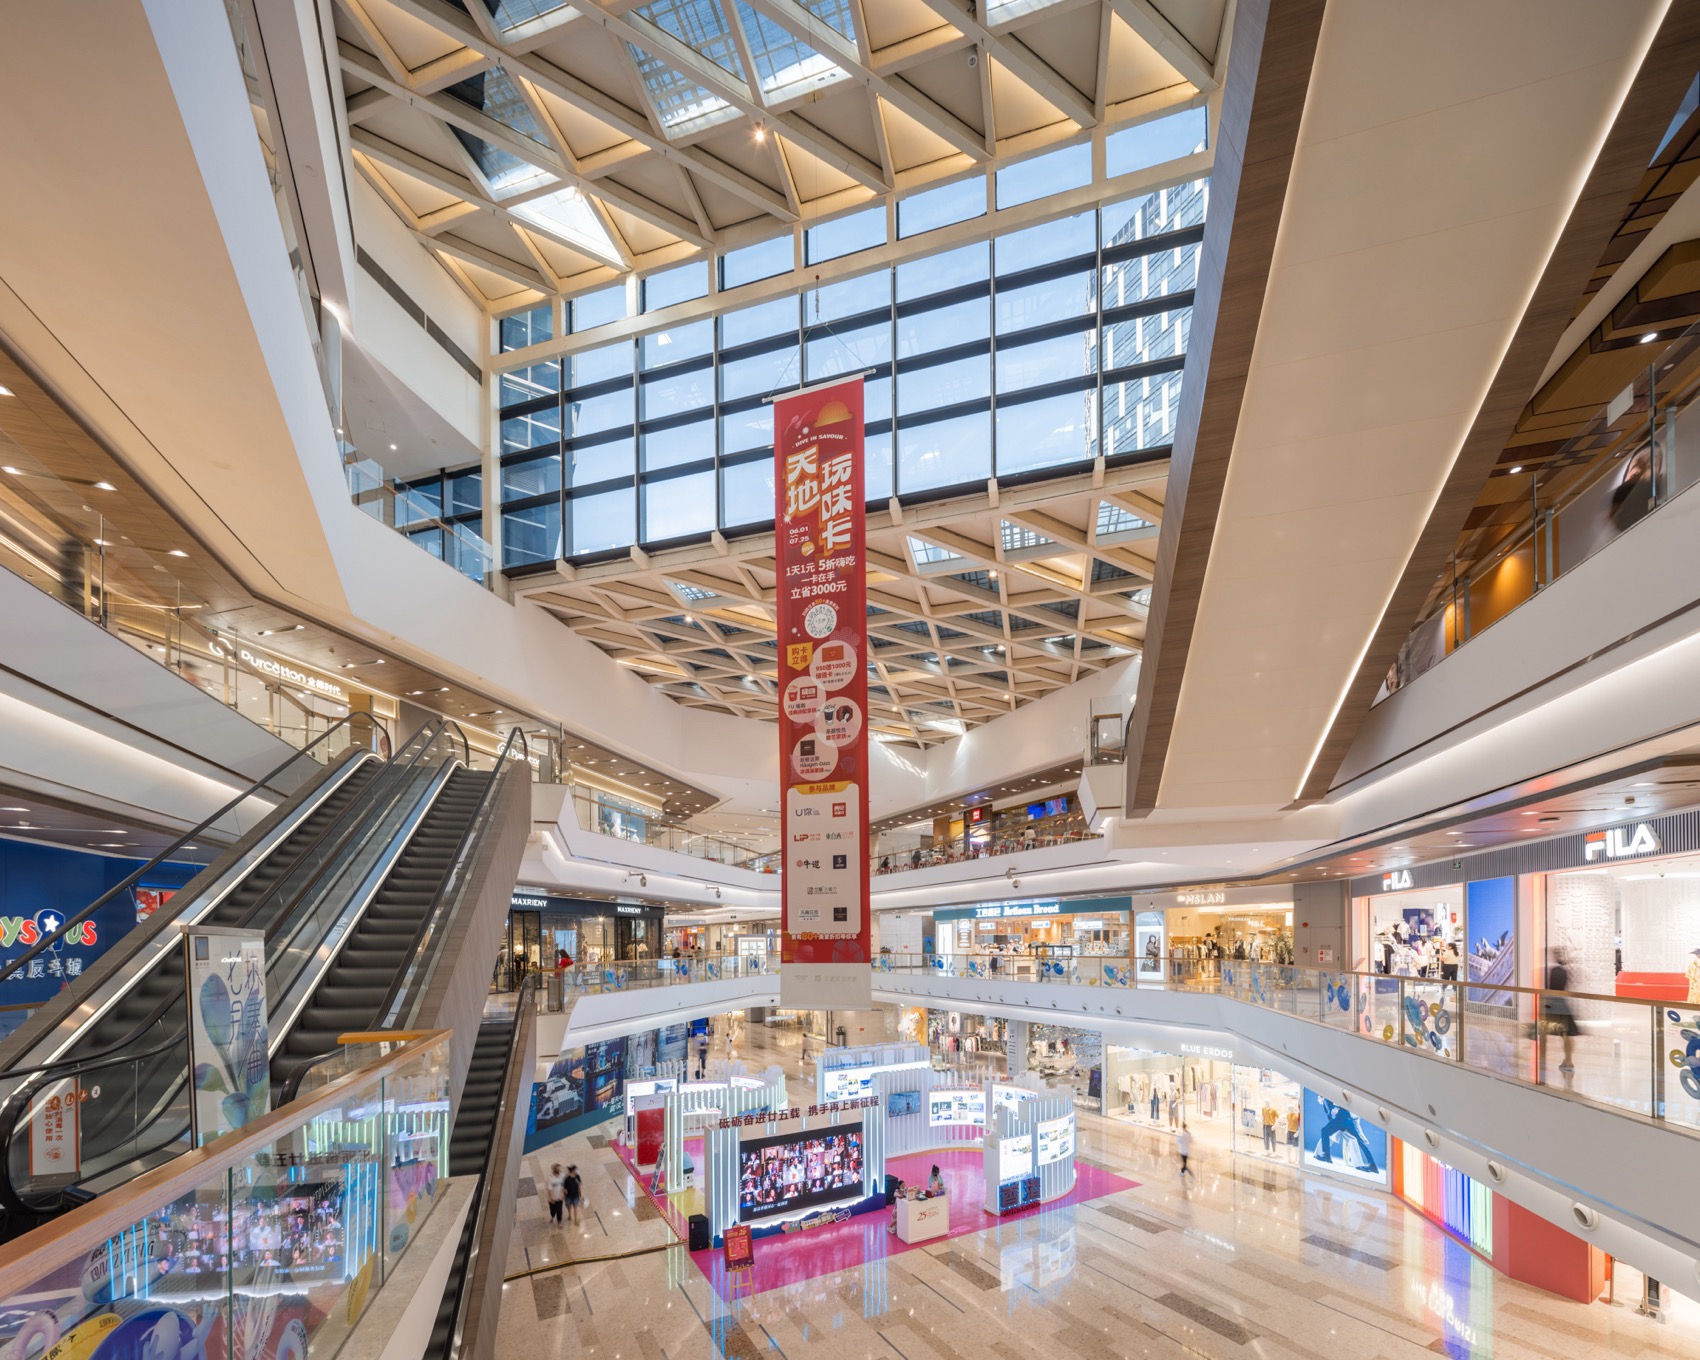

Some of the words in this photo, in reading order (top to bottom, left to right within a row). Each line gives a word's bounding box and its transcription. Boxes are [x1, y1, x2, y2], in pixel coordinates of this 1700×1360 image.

[795, 438, 809, 447] DIVE
[789, 526, 809, 535] 06.01
[789, 536, 810, 545] 07.25
[786, 562, 816, 577] 1天1元
[818, 555, 856, 571] 5折嗨吃
[801, 571, 836, 584] 一卡在手
[790, 580, 847, 600] 立省3000元
[791, 646, 808, 656] 购卡
[791, 655, 808, 665] 立得
[808, 784, 836, 793] 参与品牌
[1585, 823, 1659, 861] FILA
[1382, 870, 1412, 891] FILA
[511, 897, 548, 908] MAXRIENY
[617, 906, 642, 915] MAXRIENY
[1033, 904, 1060, 914] Bread
[1181, 1043, 1201, 1054] BLUE
[1203, 1047, 1233, 1058] ERDOS
[718, 1107, 801, 1129] 砥砺奋进廿五载
[807, 1095, 880, 1117] 携手再上新征程
[1002, 1178, 1041, 1208] 香港
[917, 1211, 927, 1221] 25
